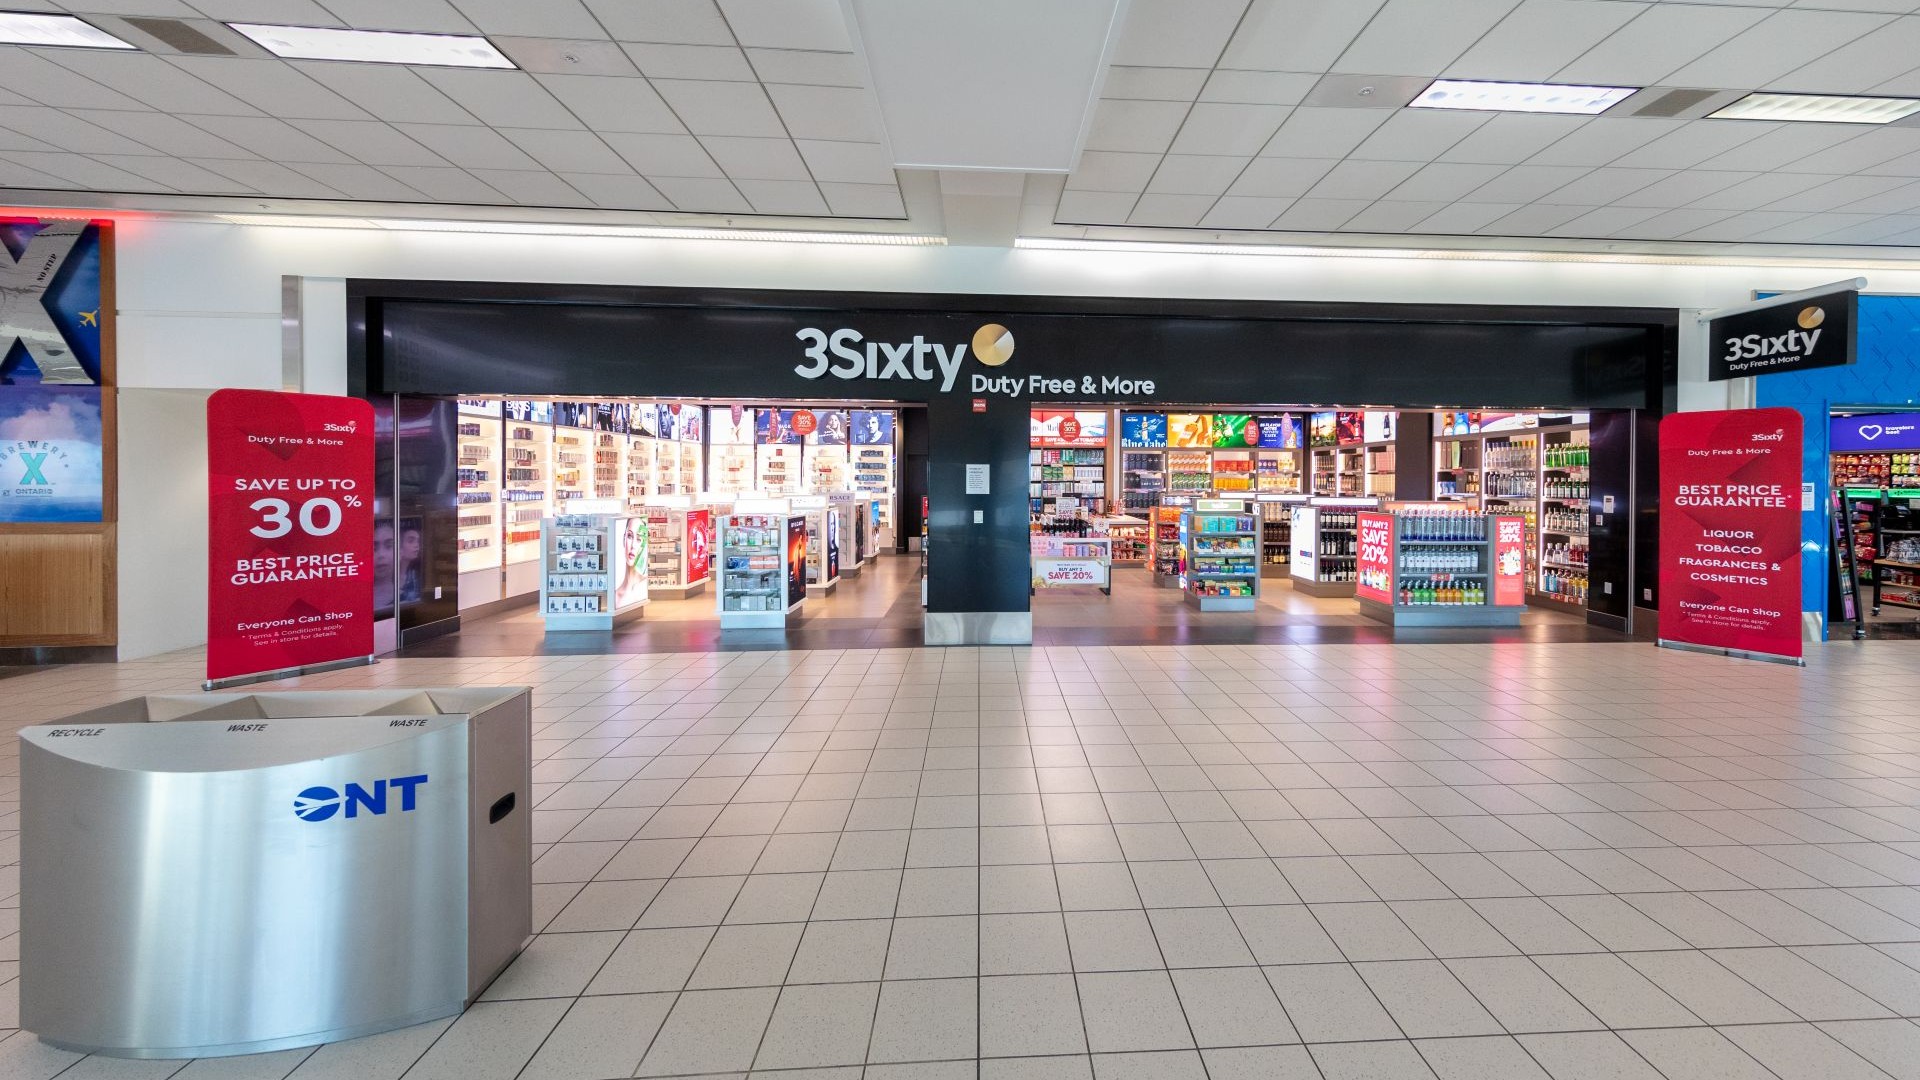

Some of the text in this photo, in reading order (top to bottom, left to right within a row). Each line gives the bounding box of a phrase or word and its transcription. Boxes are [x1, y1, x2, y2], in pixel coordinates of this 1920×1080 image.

[1724, 328, 1822, 362] 3Sixty
[794, 328, 968, 392] 3Sixty
[1729, 362, 1749, 371] Duty
[1750, 360, 1769, 368] Free
[1777, 355, 1800, 364] More
[971, 374, 1155, 398] Duty Free & More
[324, 422, 356, 434] 3Sixty
[248, 435, 275, 445] Duty
[1752, 432, 1783, 441] 3Sixty
[0, 440, 68, 461] BREWERY
[1688, 449, 1710, 457] Duty
[19, 452, 48, 485] X
[235, 478, 356, 490] SAVE UP TO
[1679, 485, 1782, 496] BEST PRICE
[249, 495, 362, 539] 30%
[1499, 525, 1520, 533] SAVE
[1703, 529, 1754, 539] LIQUOR
[1361, 528, 1389, 546] SAVE
[1499, 534, 1520, 542] 20%
[1361, 543, 1389, 565] 20%
[1696, 543, 1762, 554] TOBACCO
[237, 552, 354, 572] BEST PRICE
[1679, 557, 1781, 571] FRAGRANCES &
[1048, 571, 1093, 580] SAVE 20%
[1690, 572, 1768, 586] COSMETICS
[1680, 600, 1781, 618] Everyone Can Shop
[237, 611, 353, 631] Everyone Can Shop
[248, 633, 272, 641] Terms
[281, 627, 322, 637] Conditions
[226, 723, 269, 733] WASTE
[389, 719, 430, 728] WASTE
[47, 728, 106, 738] RECYCLE
